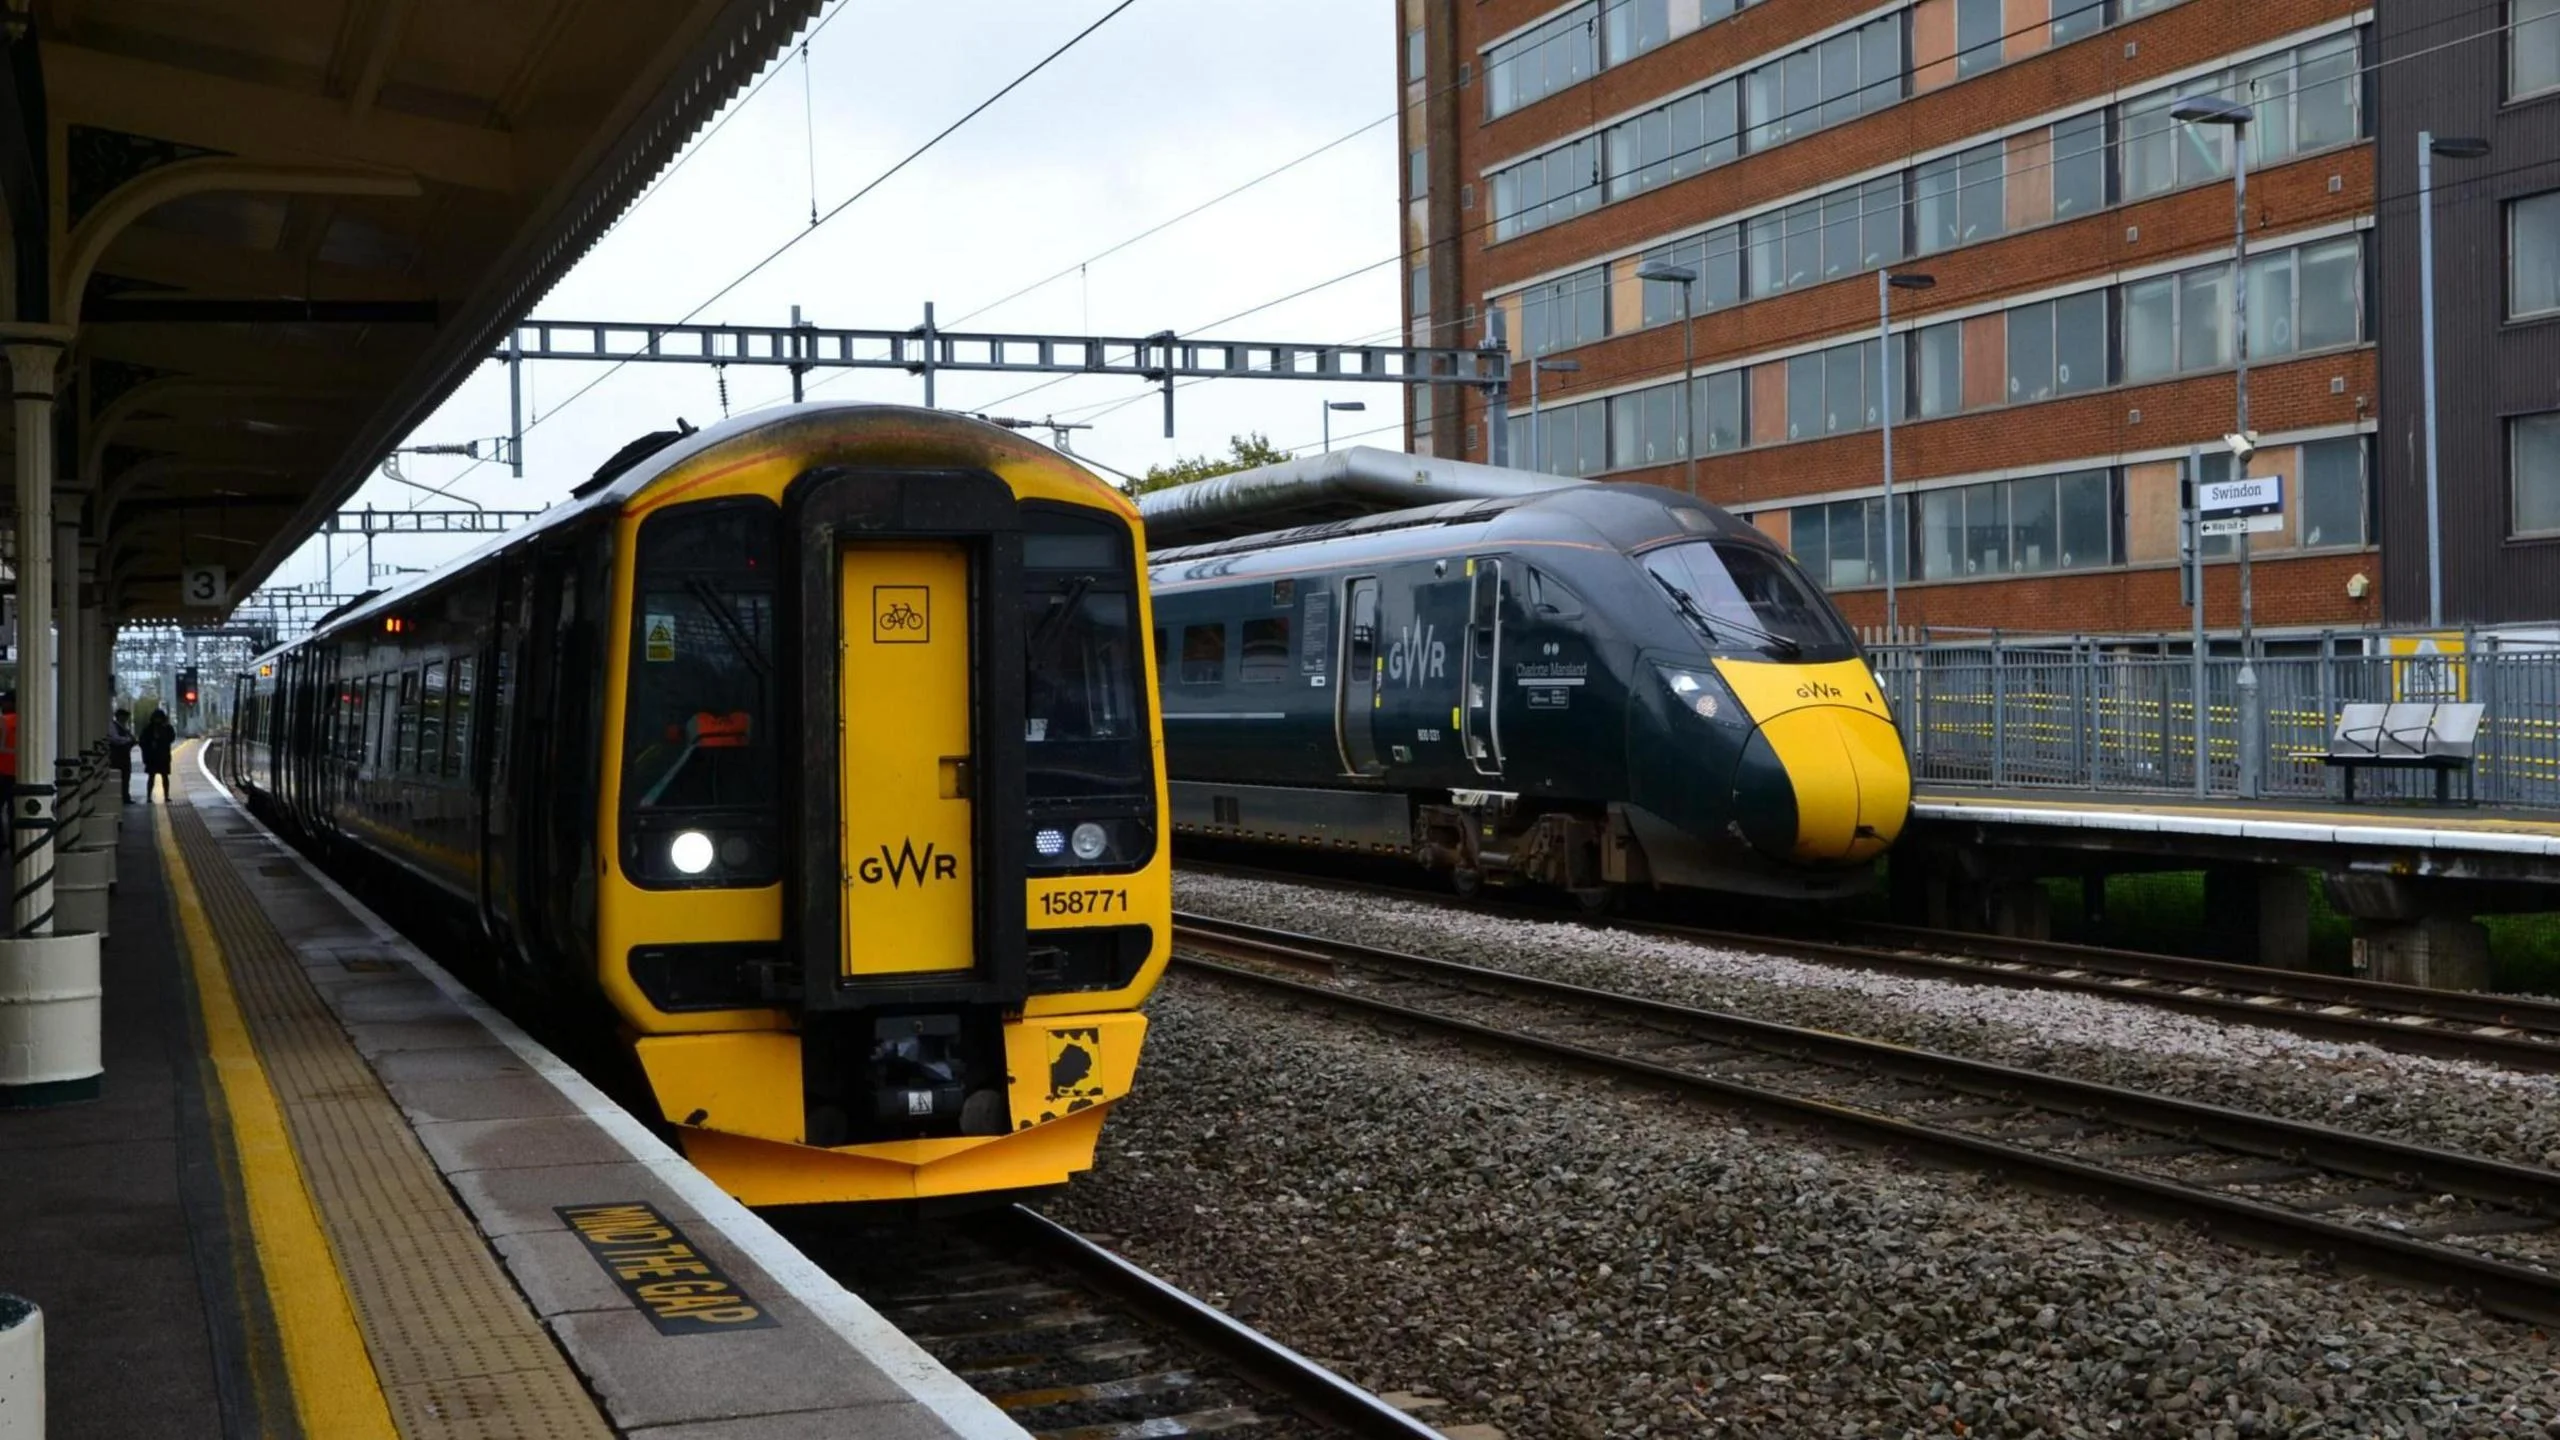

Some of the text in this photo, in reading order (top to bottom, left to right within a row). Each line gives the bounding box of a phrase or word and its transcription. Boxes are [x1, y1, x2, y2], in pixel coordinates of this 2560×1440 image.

[2211, 483, 2262, 501] Swindon
[2211, 520, 2238, 532] Way out
[193, 571, 216, 599] 3
[1388, 612, 1446, 689] GWR
[1796, 681, 1842, 699] GWR
[859, 836, 957, 889] GWR
[1040, 889, 1128, 916] 158771
[566, 1205, 760, 1323] MIND THE GAP
